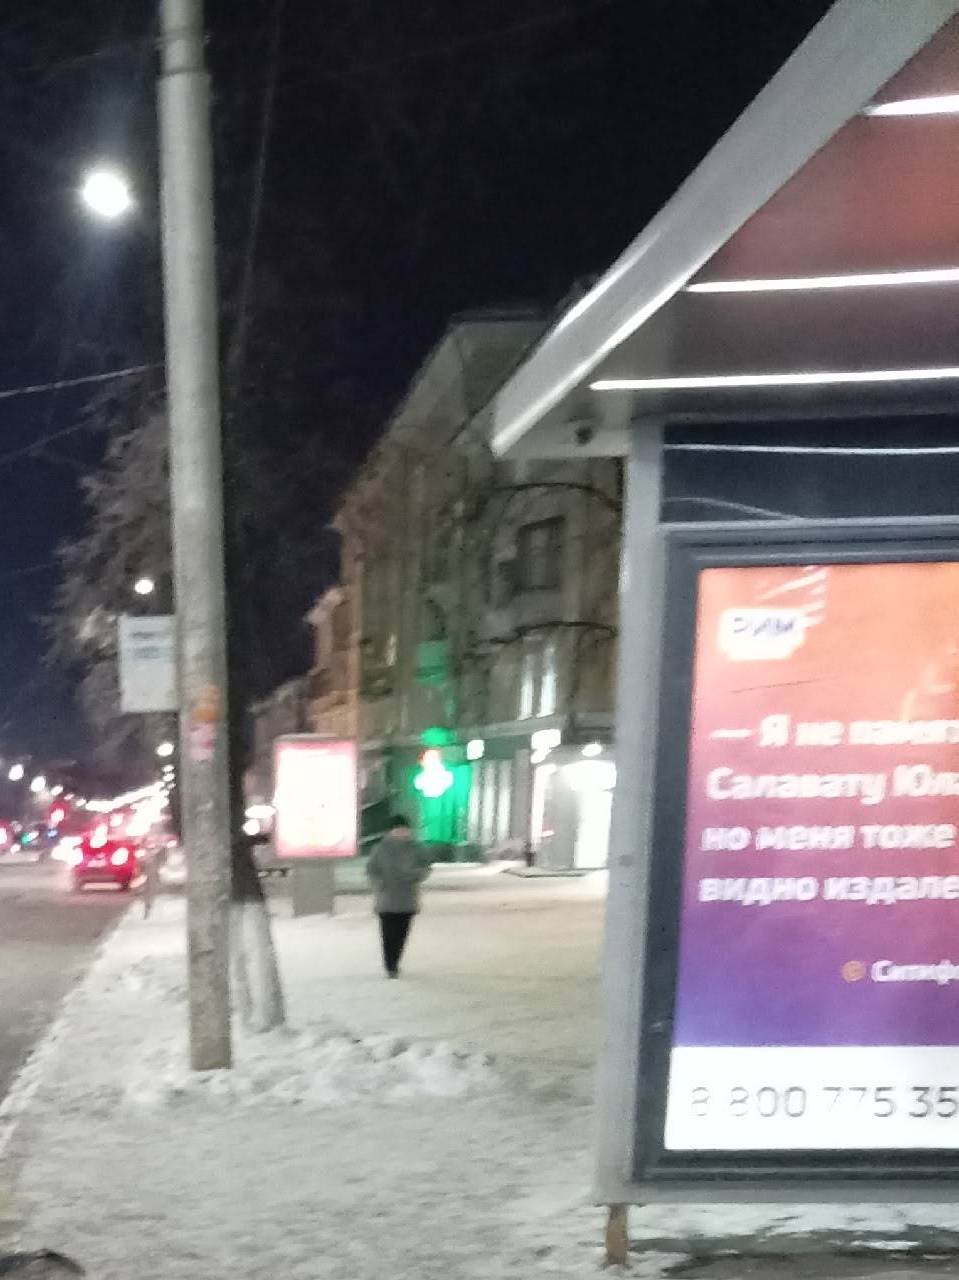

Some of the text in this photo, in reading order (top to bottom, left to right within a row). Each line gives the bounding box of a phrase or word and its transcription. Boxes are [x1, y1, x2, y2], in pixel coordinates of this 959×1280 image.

[759, 714, 790, 746] Я
[706, 767, 887, 806] Салавату
[701, 823, 957, 850] но меня тоже
[698, 877, 819, 906] видно
[691, 1085, 709, 1116] 8
[730, 1086, 808, 1117] 800
[822, 1086, 895, 1117] 775
